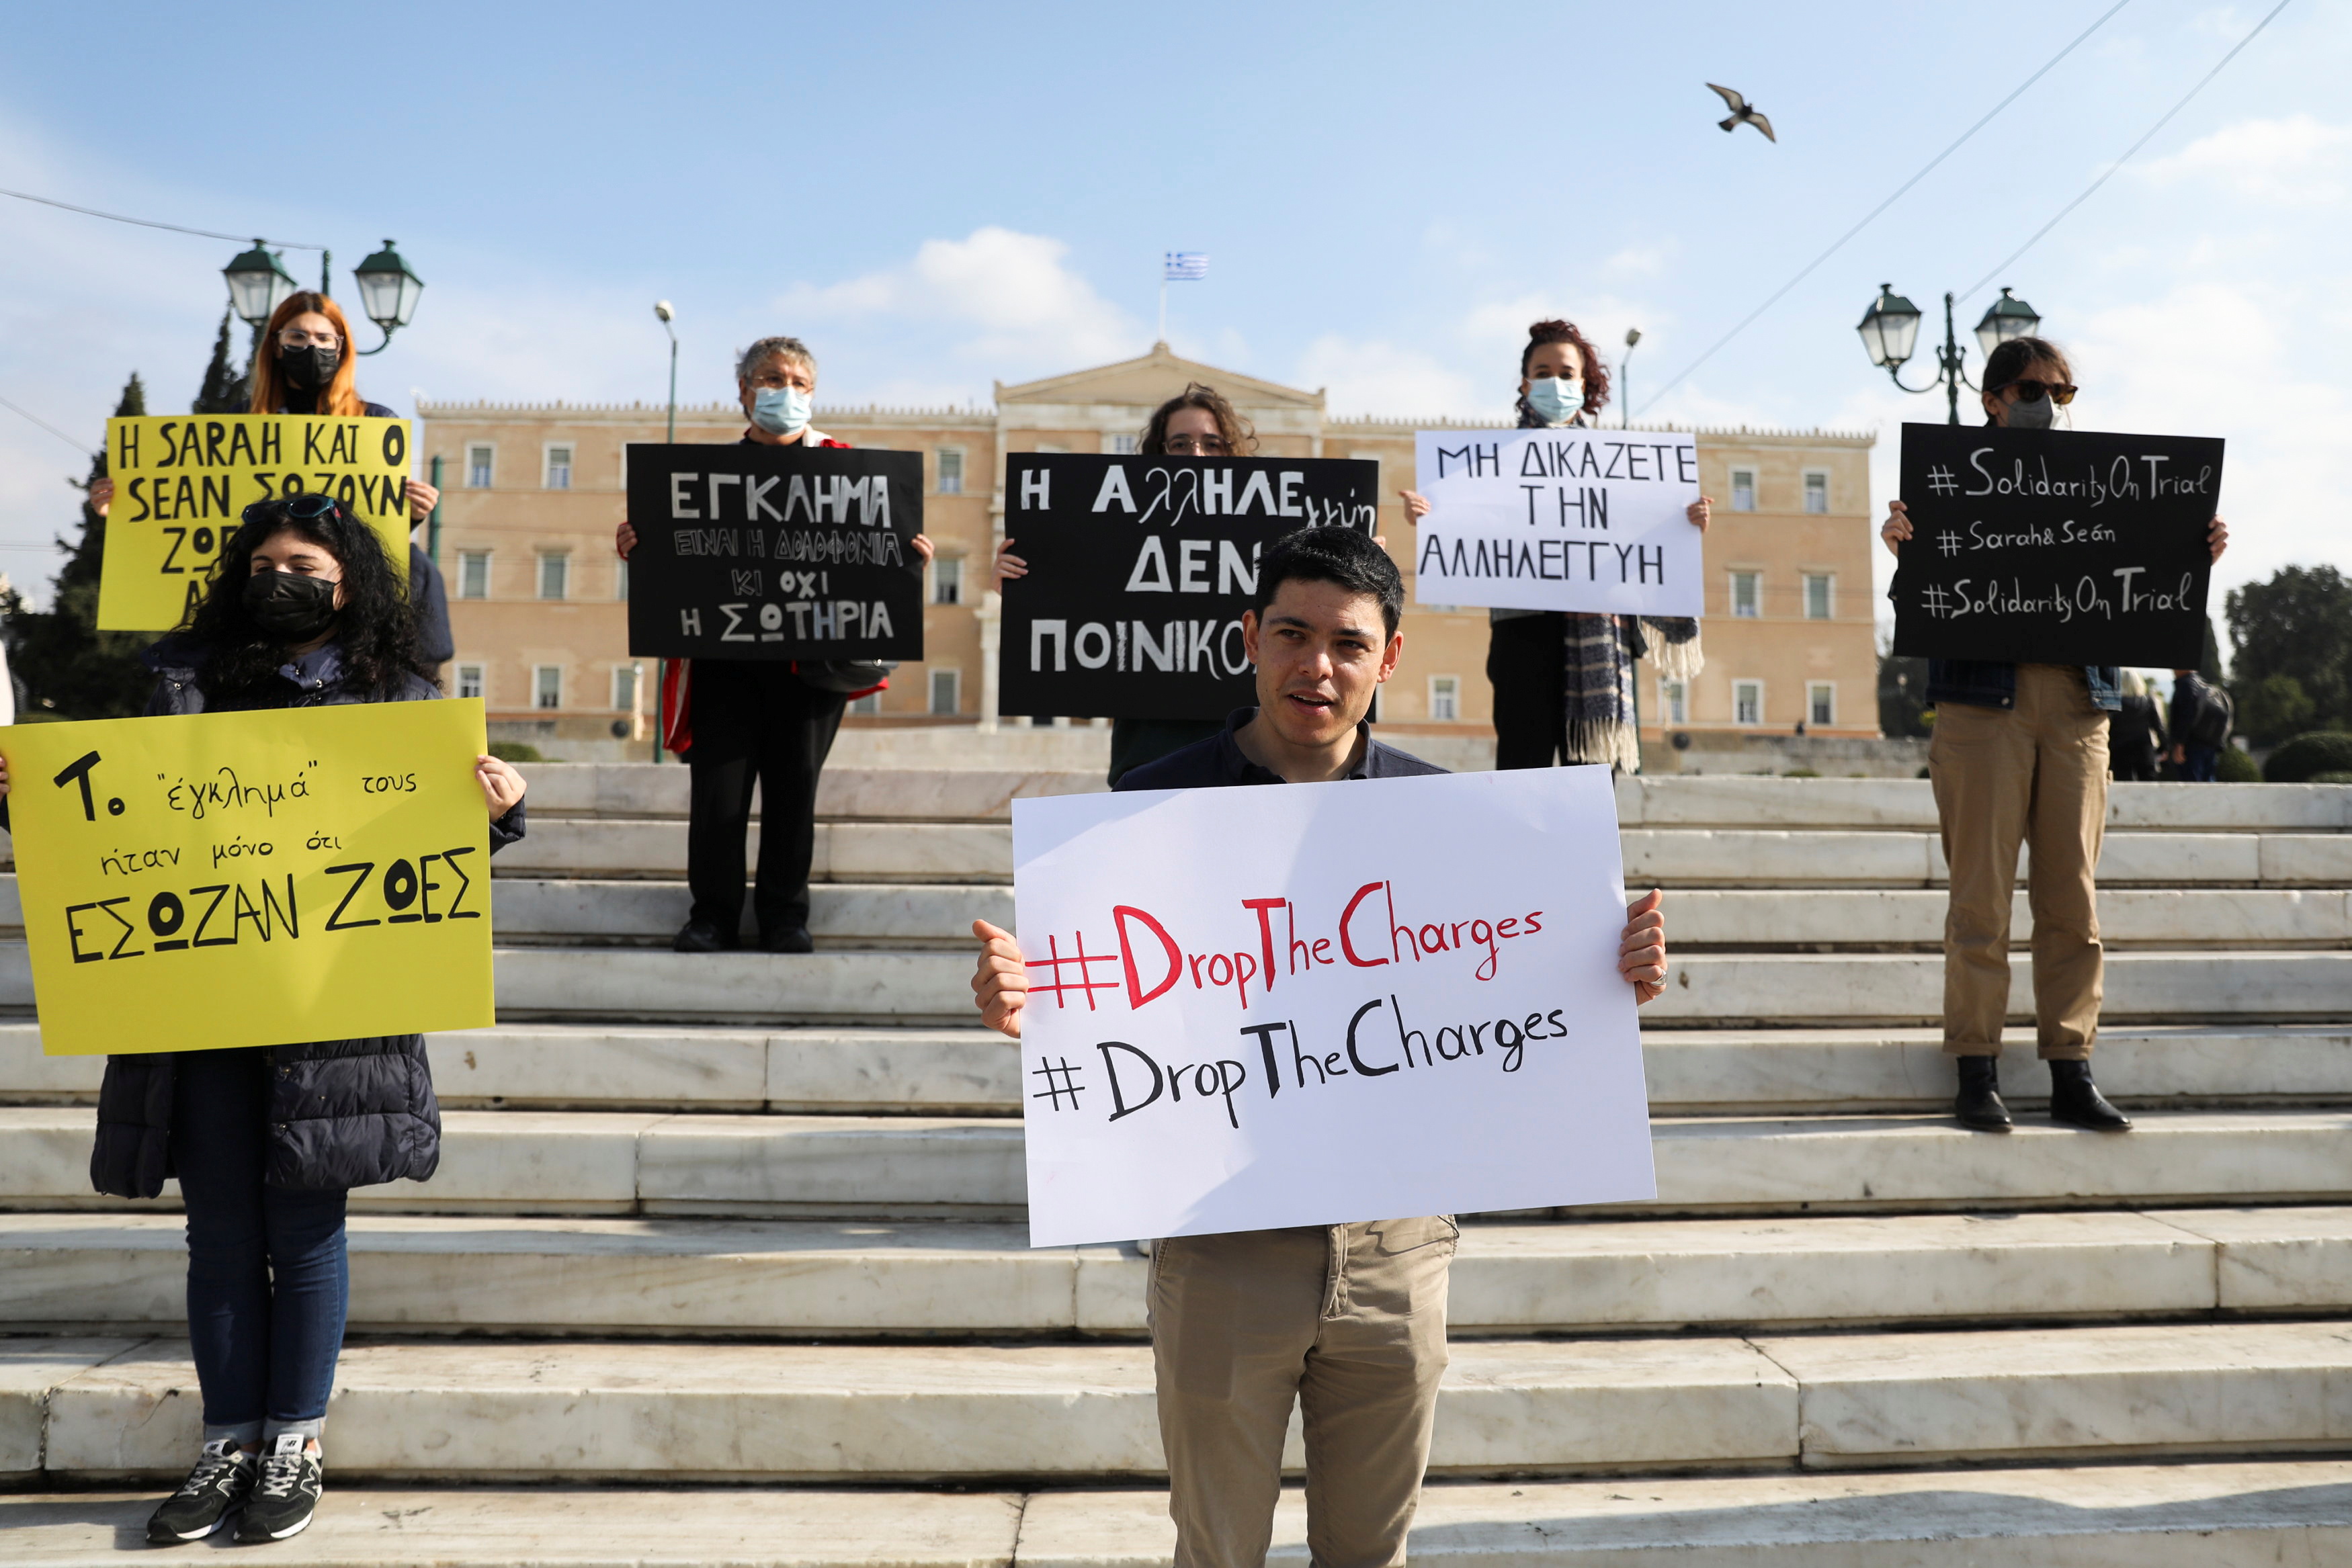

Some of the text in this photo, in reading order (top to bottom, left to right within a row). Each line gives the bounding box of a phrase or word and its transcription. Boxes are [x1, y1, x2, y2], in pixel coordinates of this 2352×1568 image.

[120, 421, 405, 470] Η SARAH ΚΑΙ Ο
[1437, 441, 1697, 483] ΜΗ ΔΙΚΑΖΕΤΕ
[128, 474, 230, 523] SEAN
[671, 472, 892, 528] ΕΓΚΛΗΜΑ
[1021, 469, 1050, 511] Η
[1520, 485, 1607, 529] ΤΗΝ
[673, 528, 905, 567] ΕΙΝΑΙ Η ΔΟΛΟΦΟΝΙΑ
[1125, 535, 1262, 595] ΔΕΝ
[1419, 534, 1663, 584] ΑΛΛΗΛΕΓΓΥΗ
[731, 569, 828, 599] ΚΙ ΟΧΙ
[681, 601, 894, 642] Η ΣΩΤΗΡΙΑ
[1031, 618, 1257, 681] ΠΟΙΝΙΚΟ
[362, 773, 417, 793] τους
[101, 830, 342, 875] ήταν μόνο ότι
[65, 846, 481, 964] ΕΣΩΖΑΝ ΖΩΕΣ
[1025, 879, 1544, 1010] #DropTheCharges
